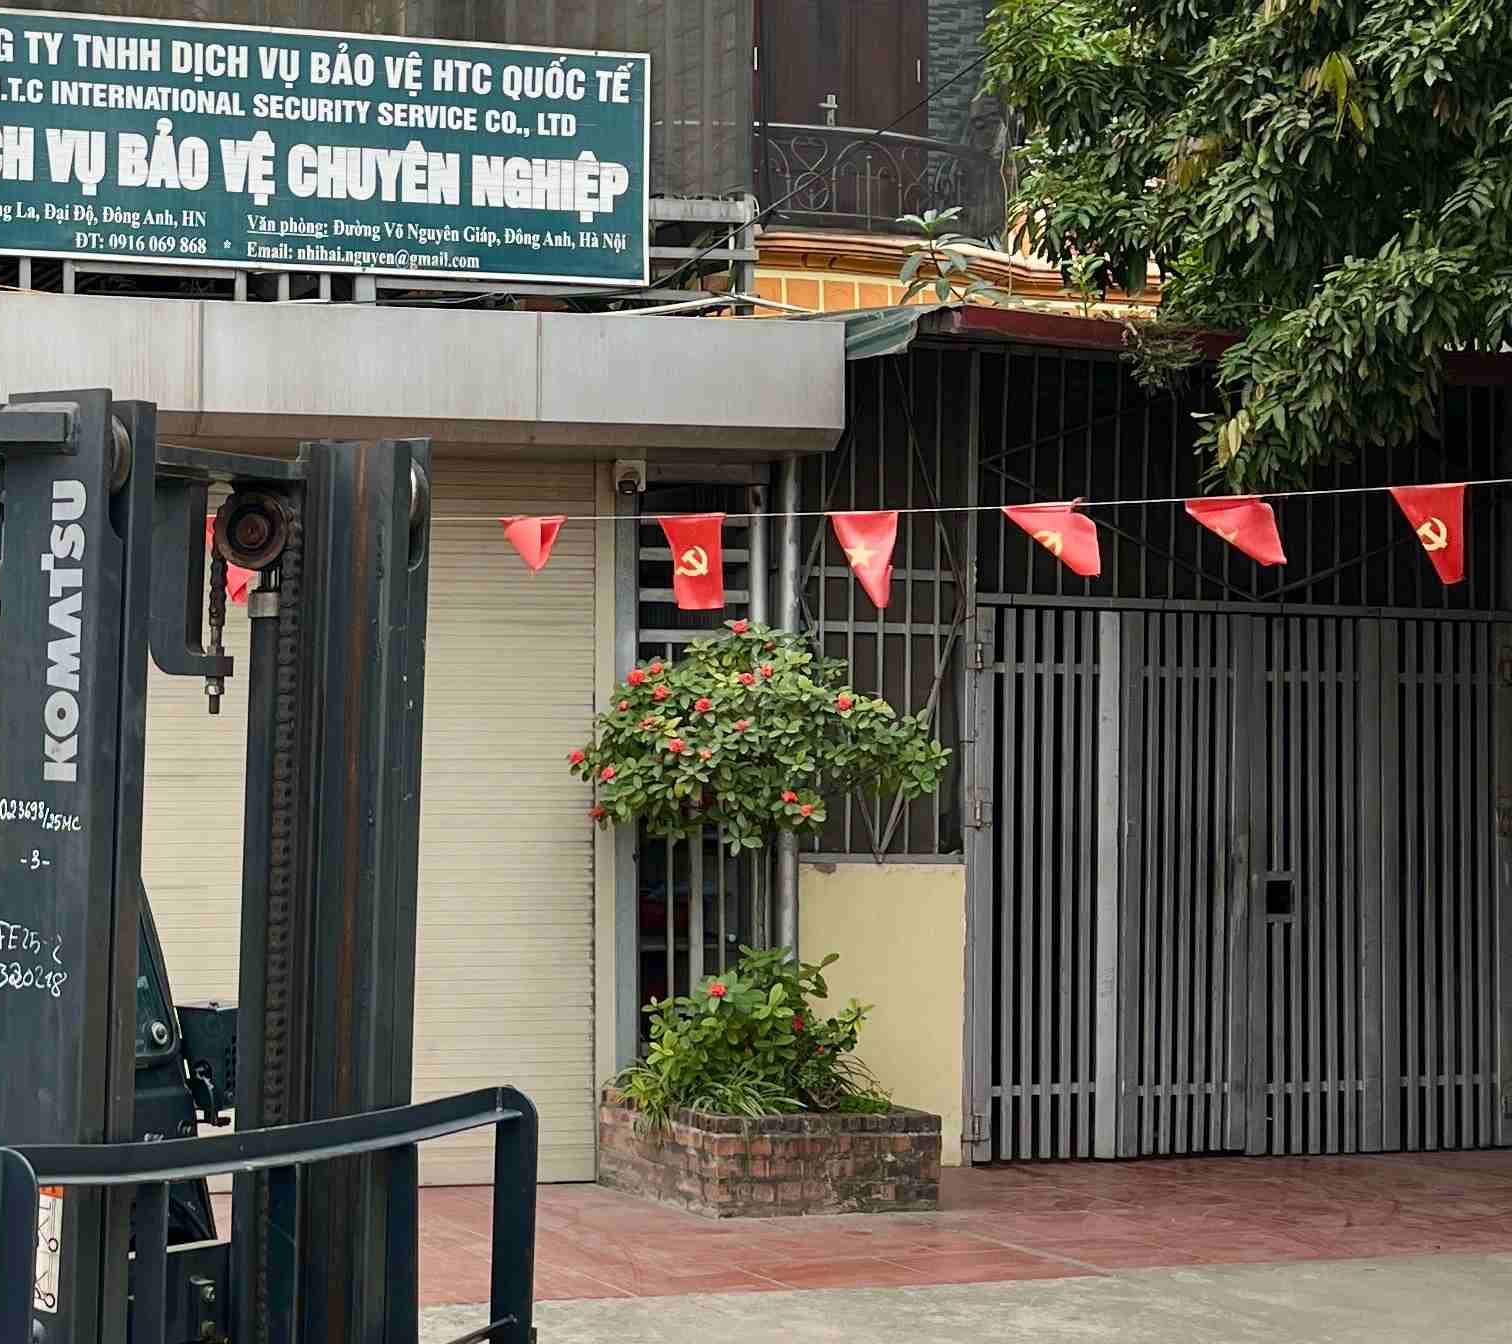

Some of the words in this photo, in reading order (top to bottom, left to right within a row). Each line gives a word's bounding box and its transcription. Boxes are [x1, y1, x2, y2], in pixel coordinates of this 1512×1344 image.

[23, 30, 64, 65] TY
[73, 33, 161, 72] TNHH
[171, 40, 249, 83] DỊCH
[258, 46, 300, 89] VỤ
[310, 42, 376, 87] BẢO
[384, 51, 423, 97] VỆ
[433, 58, 493, 95] HTC
[502, 56, 586, 101] QUỐC
[595, 62, 635, 104] TẾ
[51, 80, 246, 117] INTERNATIONAL
[252, 93, 371, 124] SECURITY
[377, 102, 478, 132] SERVICE
[485, 109, 530, 138] CO.,
[537, 112, 577, 137] LTD
[45, 127, 107, 196] VỤ
[117, 117, 209, 191] BẢO
[219, 130, 276, 207] VỆ
[287, 140, 460, 206] CHUYÊN
[471, 149, 630, 223] NGHIỆP
[15, 201, 41, 222] La,
[44, 203, 70, 225] Đại
[73, 204, 99, 225] Độ,
[102, 206, 141, 229] Đông
[142, 209, 178, 229] Anh,
[182, 210, 208, 228] HN
[247, 214, 277, 233] Văn
[279, 217, 328, 239] phòng:
[333, 219, 381, 241] Đường
[384, 222, 404, 239] Võ
[407, 223, 460, 245] Nguyên
[463, 226, 502, 247] Giáp,
[504, 227, 541, 250] Đông
[542, 231, 576, 250] Anh,
[578, 231, 600, 249] Hà
[602, 232, 627, 254] Nội
[75, 232, 105, 249] ĐT:
[108, 233, 146, 252] 0916
[149, 235, 176, 253] 069
[179, 237, 208, 254] 868
[247, 241, 293, 260] Email:
[297, 244, 480, 270] nhihai.nguyen@gmail.com
[40, 479, 87, 782] KOMATSU
